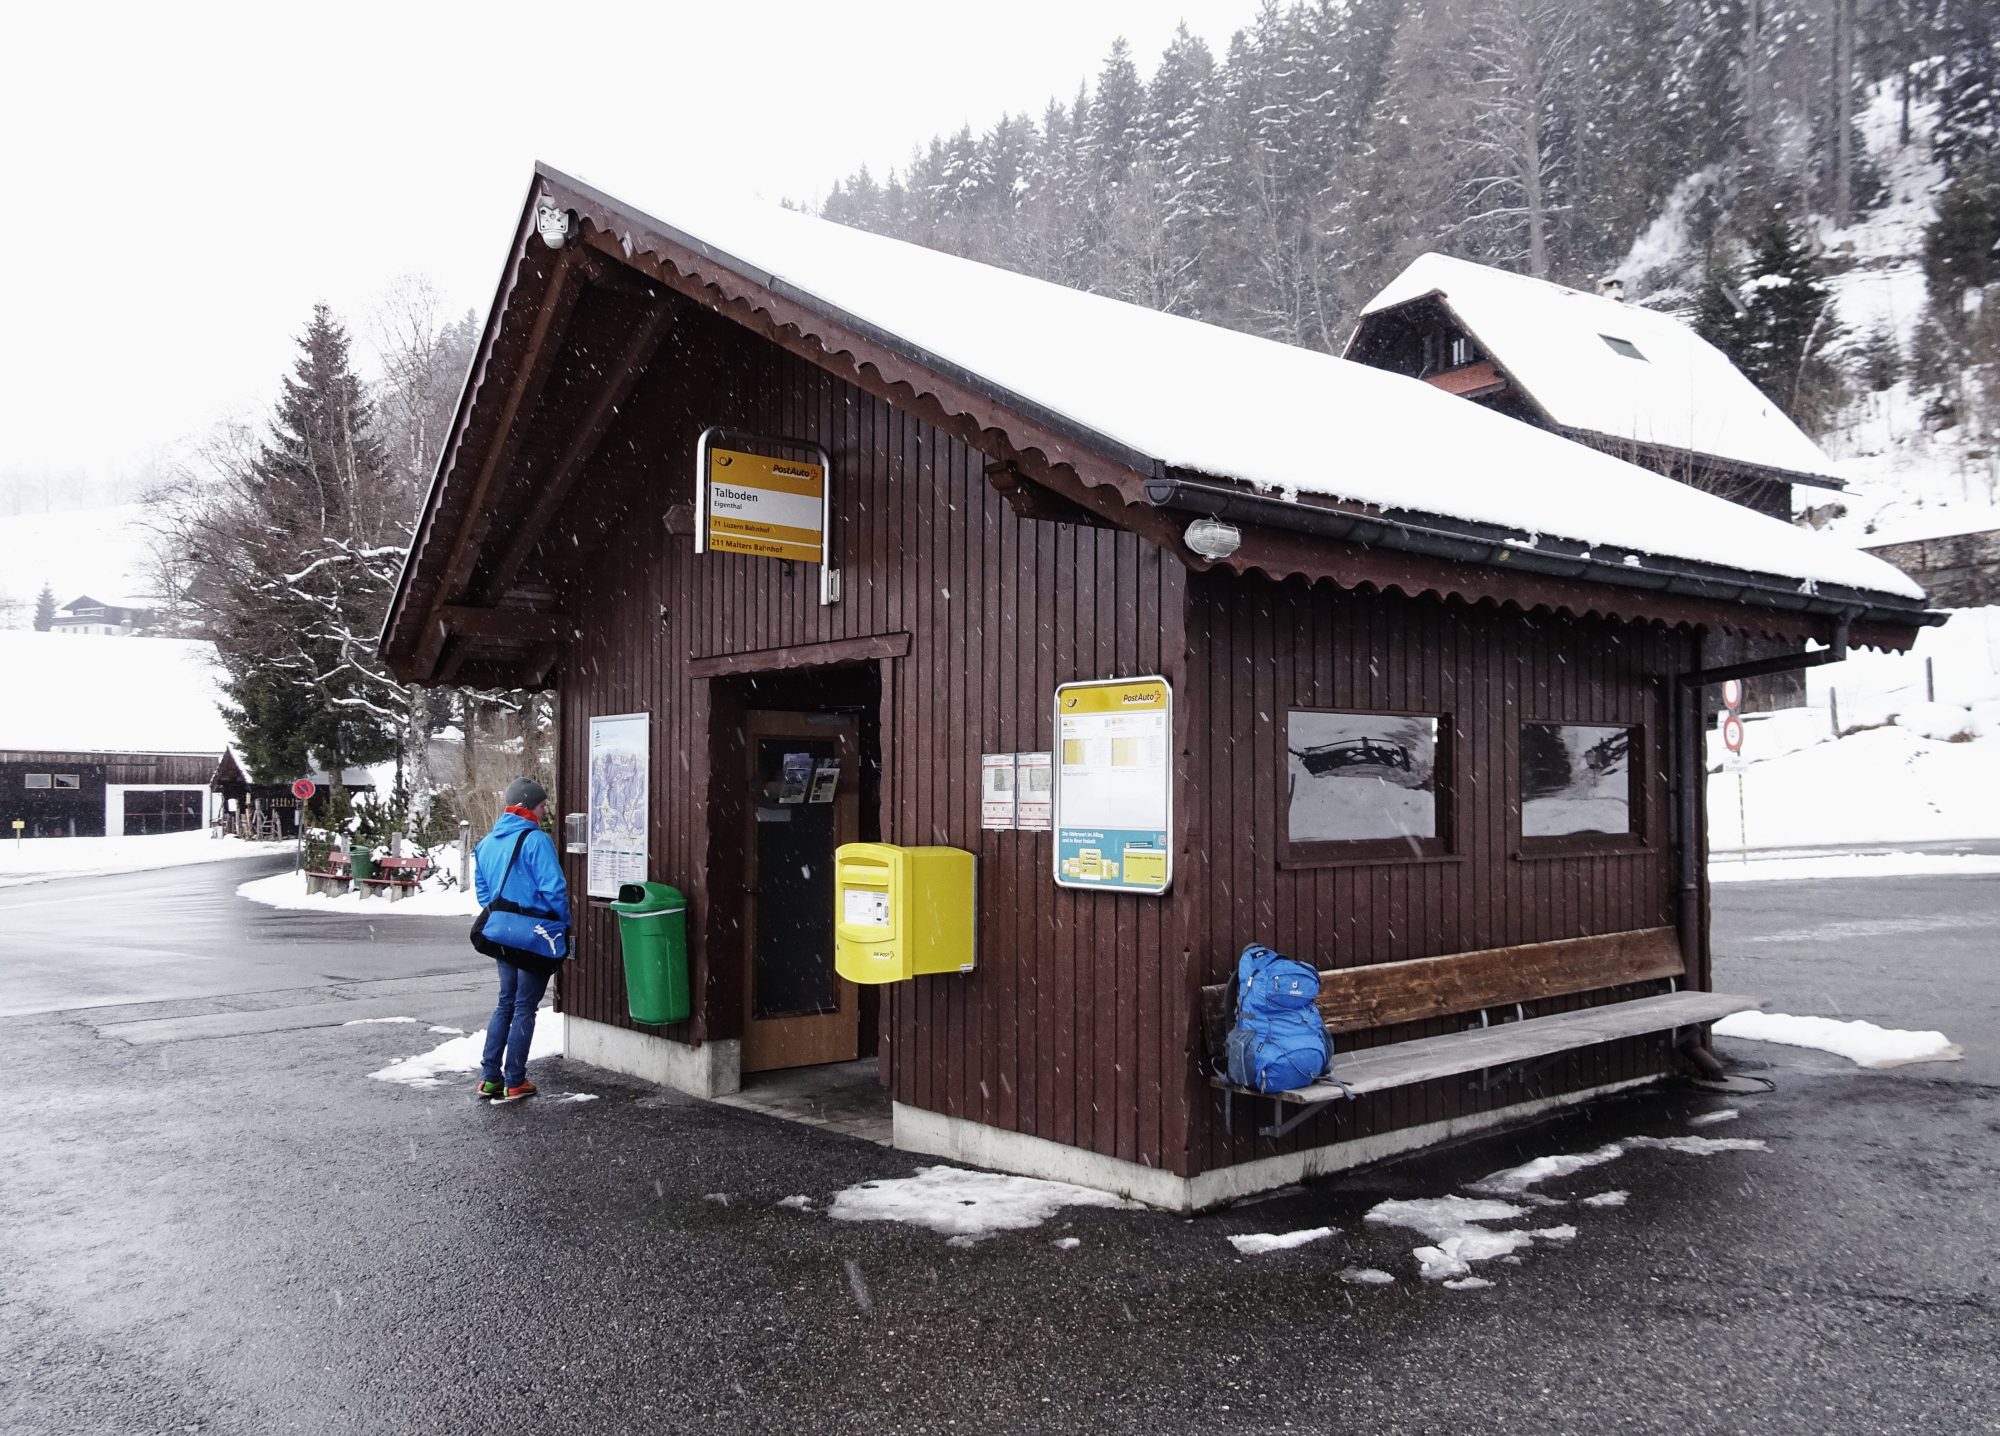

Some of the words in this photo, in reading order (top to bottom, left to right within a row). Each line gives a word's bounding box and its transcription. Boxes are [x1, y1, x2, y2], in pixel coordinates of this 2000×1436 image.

[773, 464, 810, 478] PostAuto
[715, 487, 758, 502] Talboden
[714, 501, 743, 510] Eigenthal
[723, 522, 744, 530] Luzern
[745, 524, 770, 533] Bahnhof
[711, 538, 724, 547] 211
[725, 540, 752, 550] Malters
[754, 544, 784, 553] Bahnhof
[1123, 693, 1154, 702] PostAuto
